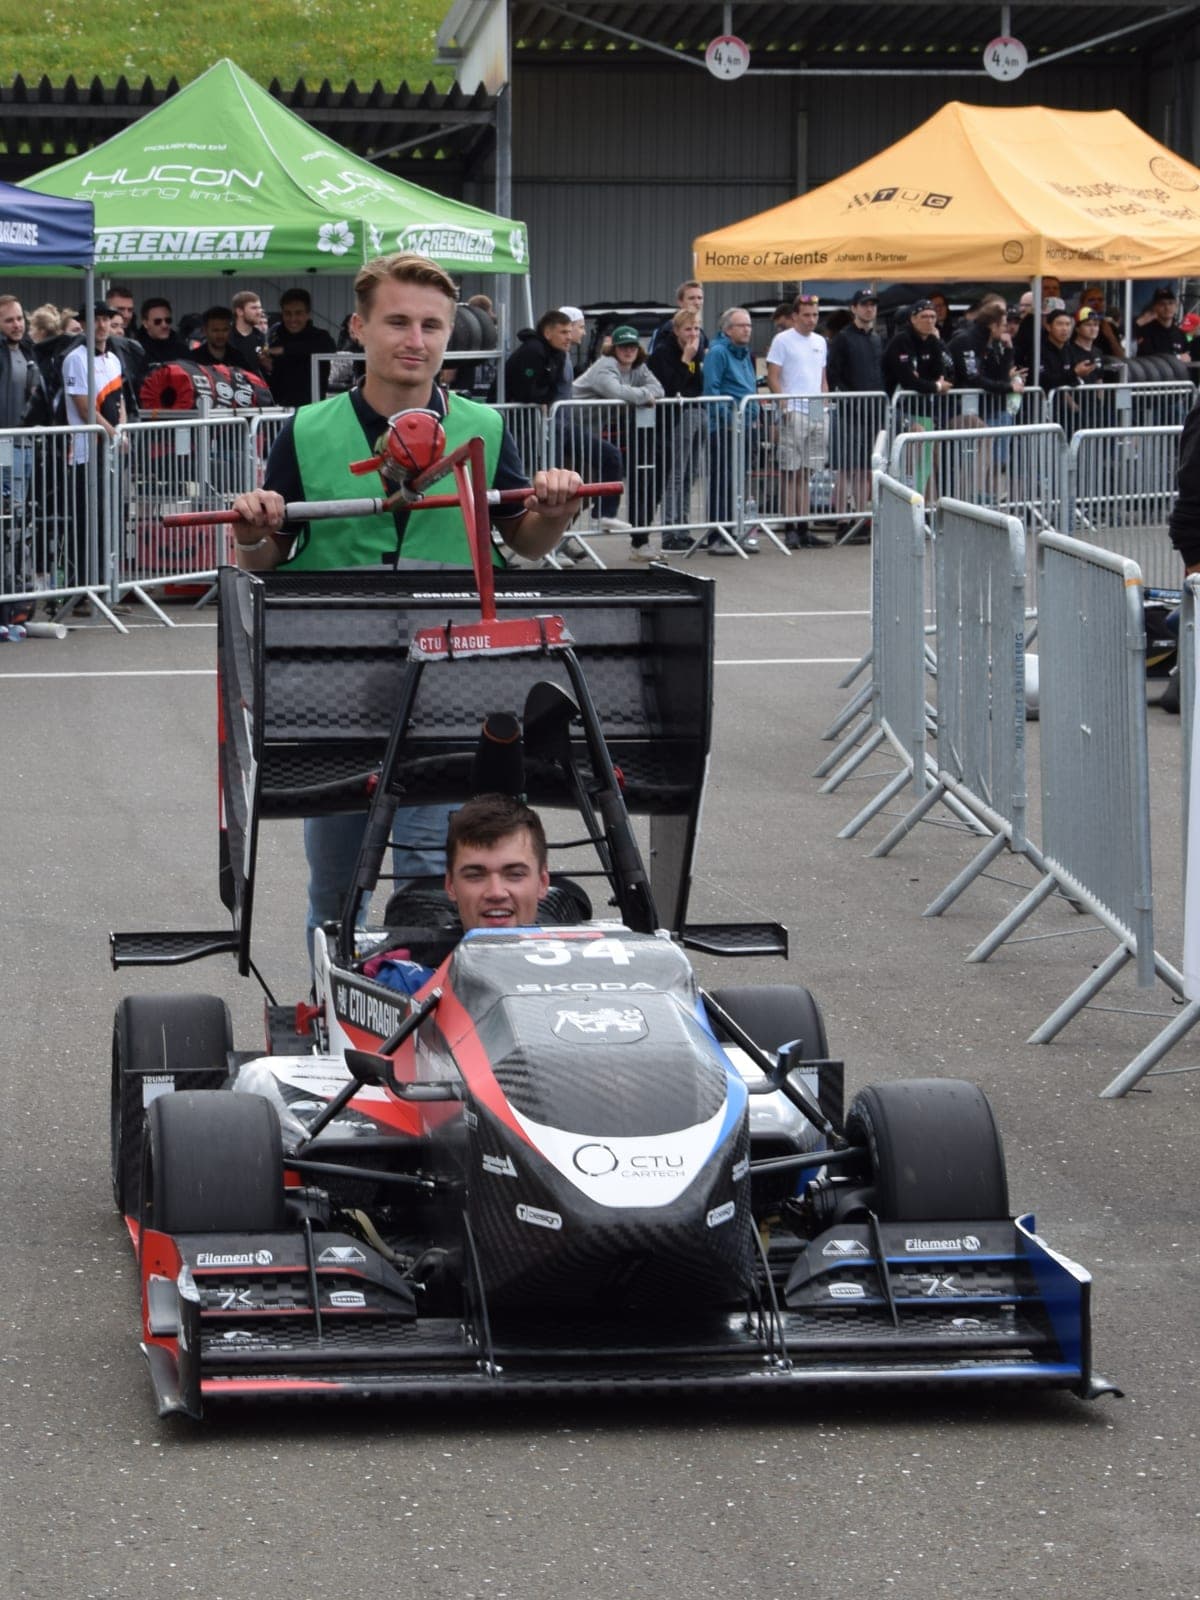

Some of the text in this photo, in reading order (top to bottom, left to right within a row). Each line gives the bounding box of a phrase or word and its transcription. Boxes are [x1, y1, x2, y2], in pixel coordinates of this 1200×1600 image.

[81, 165, 264, 188] HUCON
[0, 221, 38, 246] REMSE
[95, 227, 272, 254] REENTEAM
[705, 251, 749, 266] Home
[753, 251, 770, 265] of
[774, 250, 828, 265] Talents
[866, 254, 873, 262] &
[875, 252, 908, 262] Partner
[420, 637, 442, 650] CTU
[520, 938, 635, 966] 34
[349, 987, 366, 1026] CTU
[631, 1155, 684, 1168] CTU
[621, 1170, 686, 1178] CARTECH
[906, 1238, 961, 1251] Filament
[197, 1253, 254, 1266] Filament
